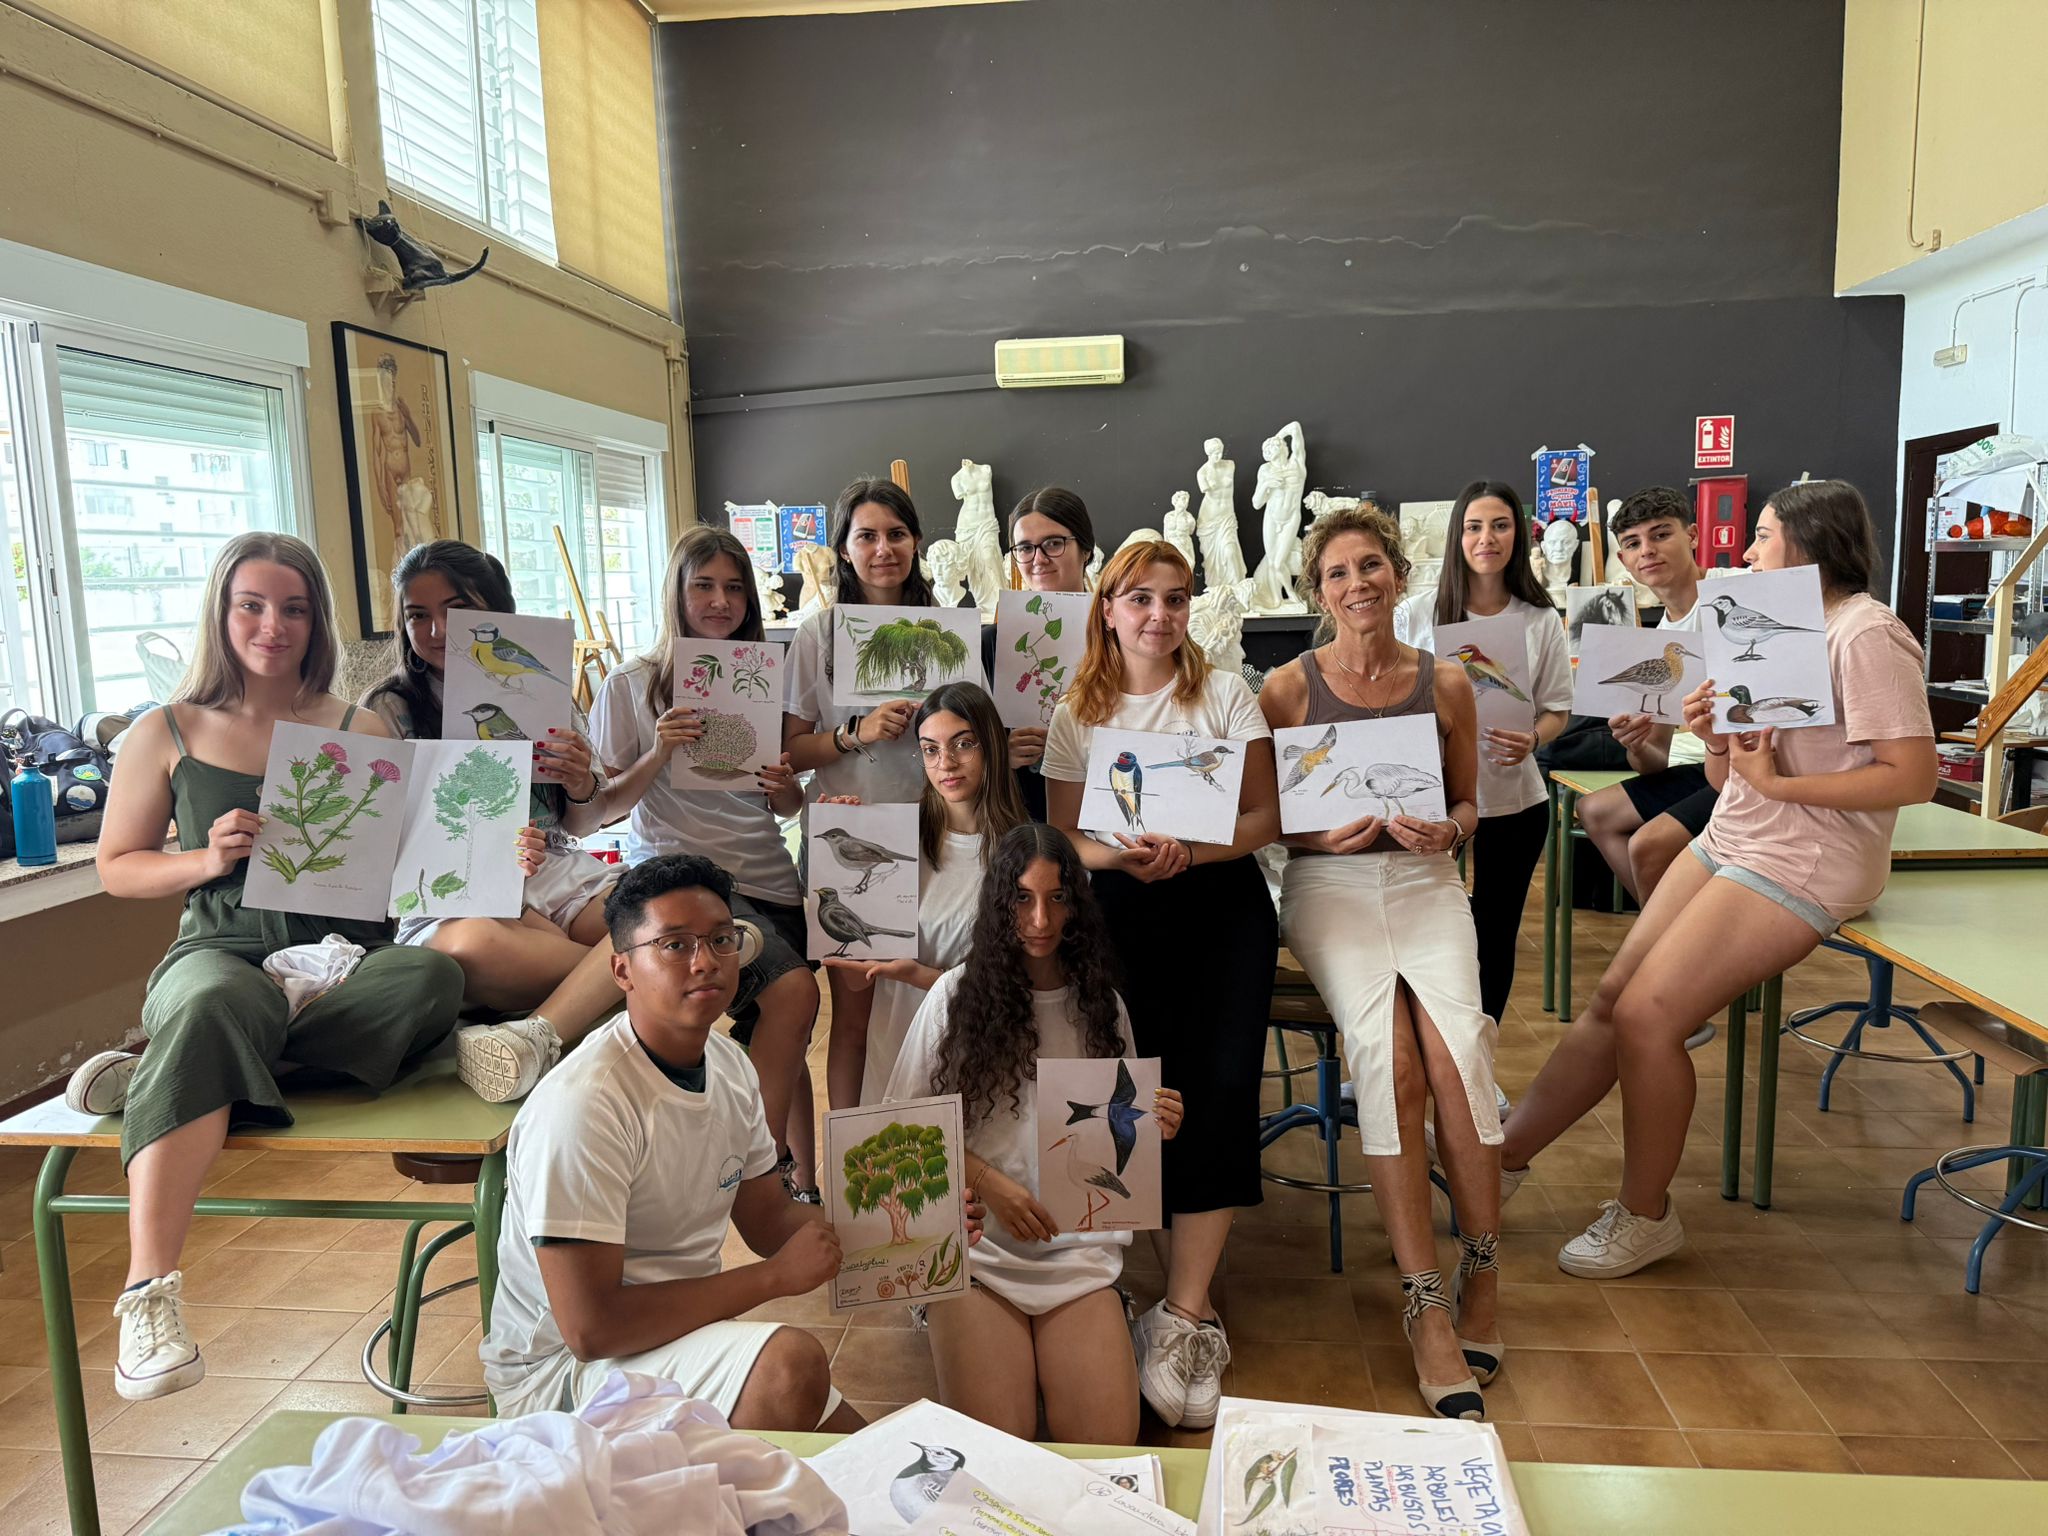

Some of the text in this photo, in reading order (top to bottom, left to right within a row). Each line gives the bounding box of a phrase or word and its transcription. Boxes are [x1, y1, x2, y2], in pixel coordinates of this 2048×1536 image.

[1698, 455, 1729, 463] EXTINTOR
[1363, 1460, 1391, 1513] PLANTAS
[1394, 1464, 1431, 1532] ARBUSTOS
[1421, 1465, 1459, 1525] ARBOLES
